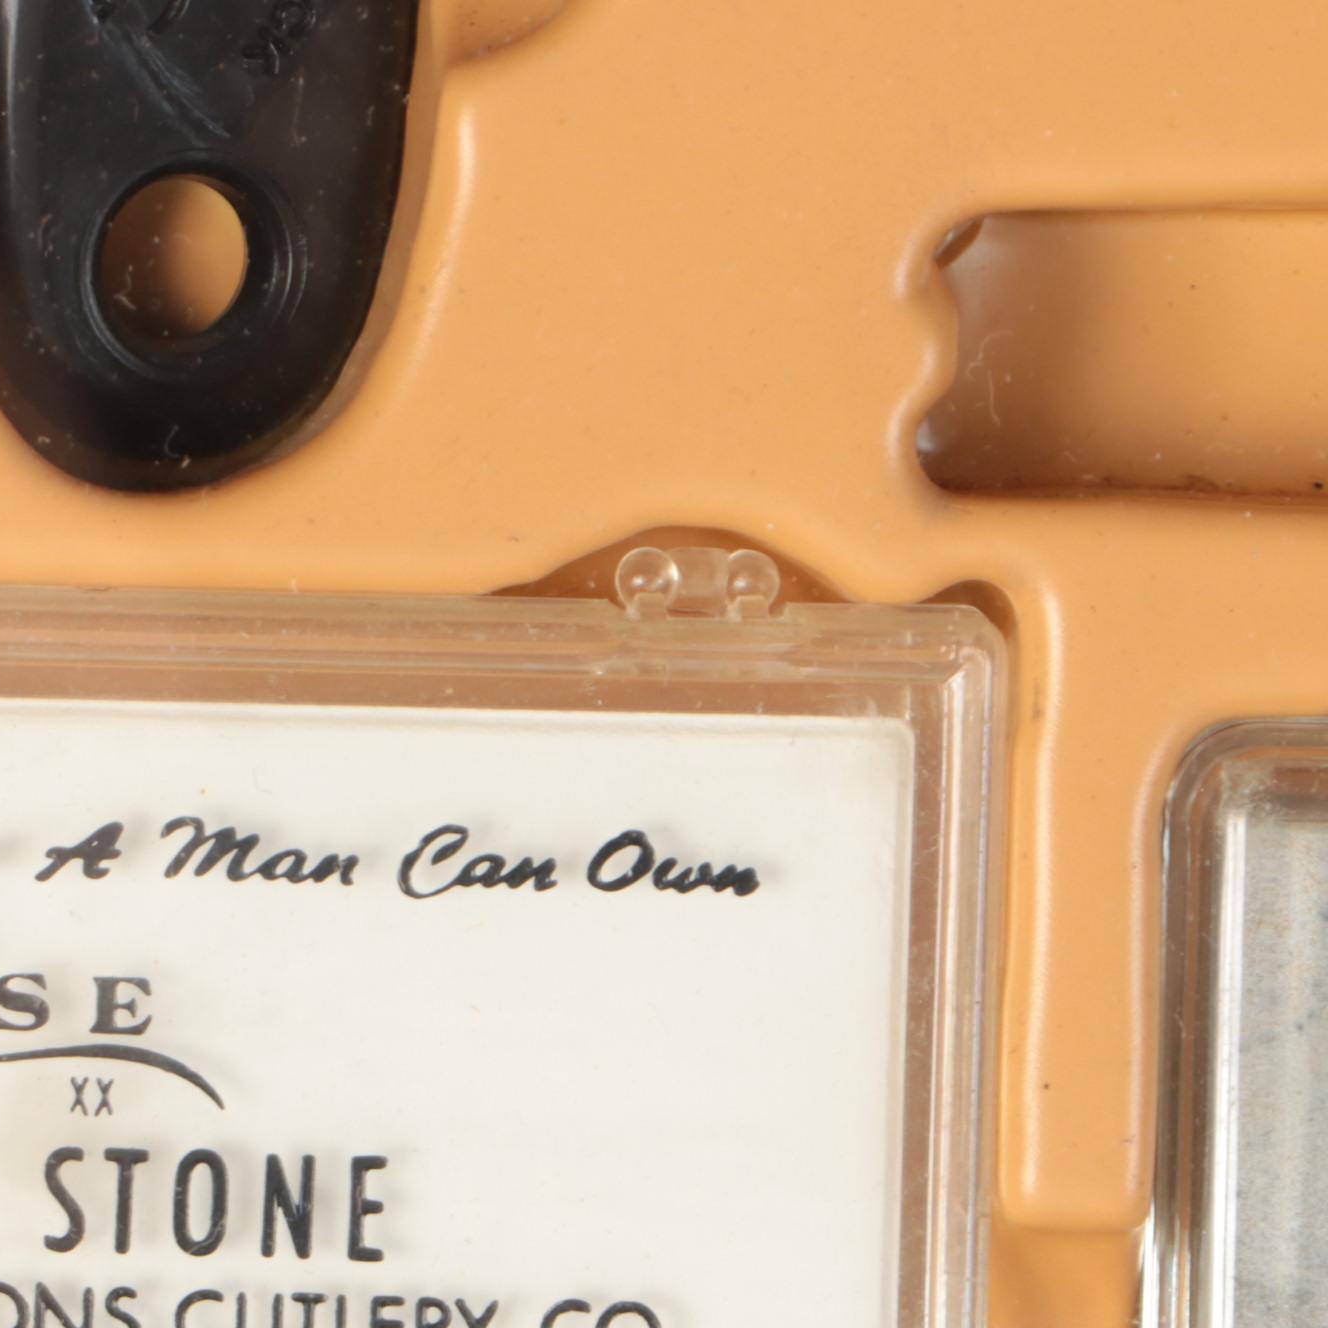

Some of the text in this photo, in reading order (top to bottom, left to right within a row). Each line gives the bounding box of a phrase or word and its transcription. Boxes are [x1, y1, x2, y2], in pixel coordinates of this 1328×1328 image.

[35, 822, 123, 882] A
[161, 817, 359, 886] Man
[398, 824, 557, 899] Can
[586, 830, 760, 897] Own
[71, 1078, 113, 1116] XX
[44, 1146, 388, 1263] STONE
